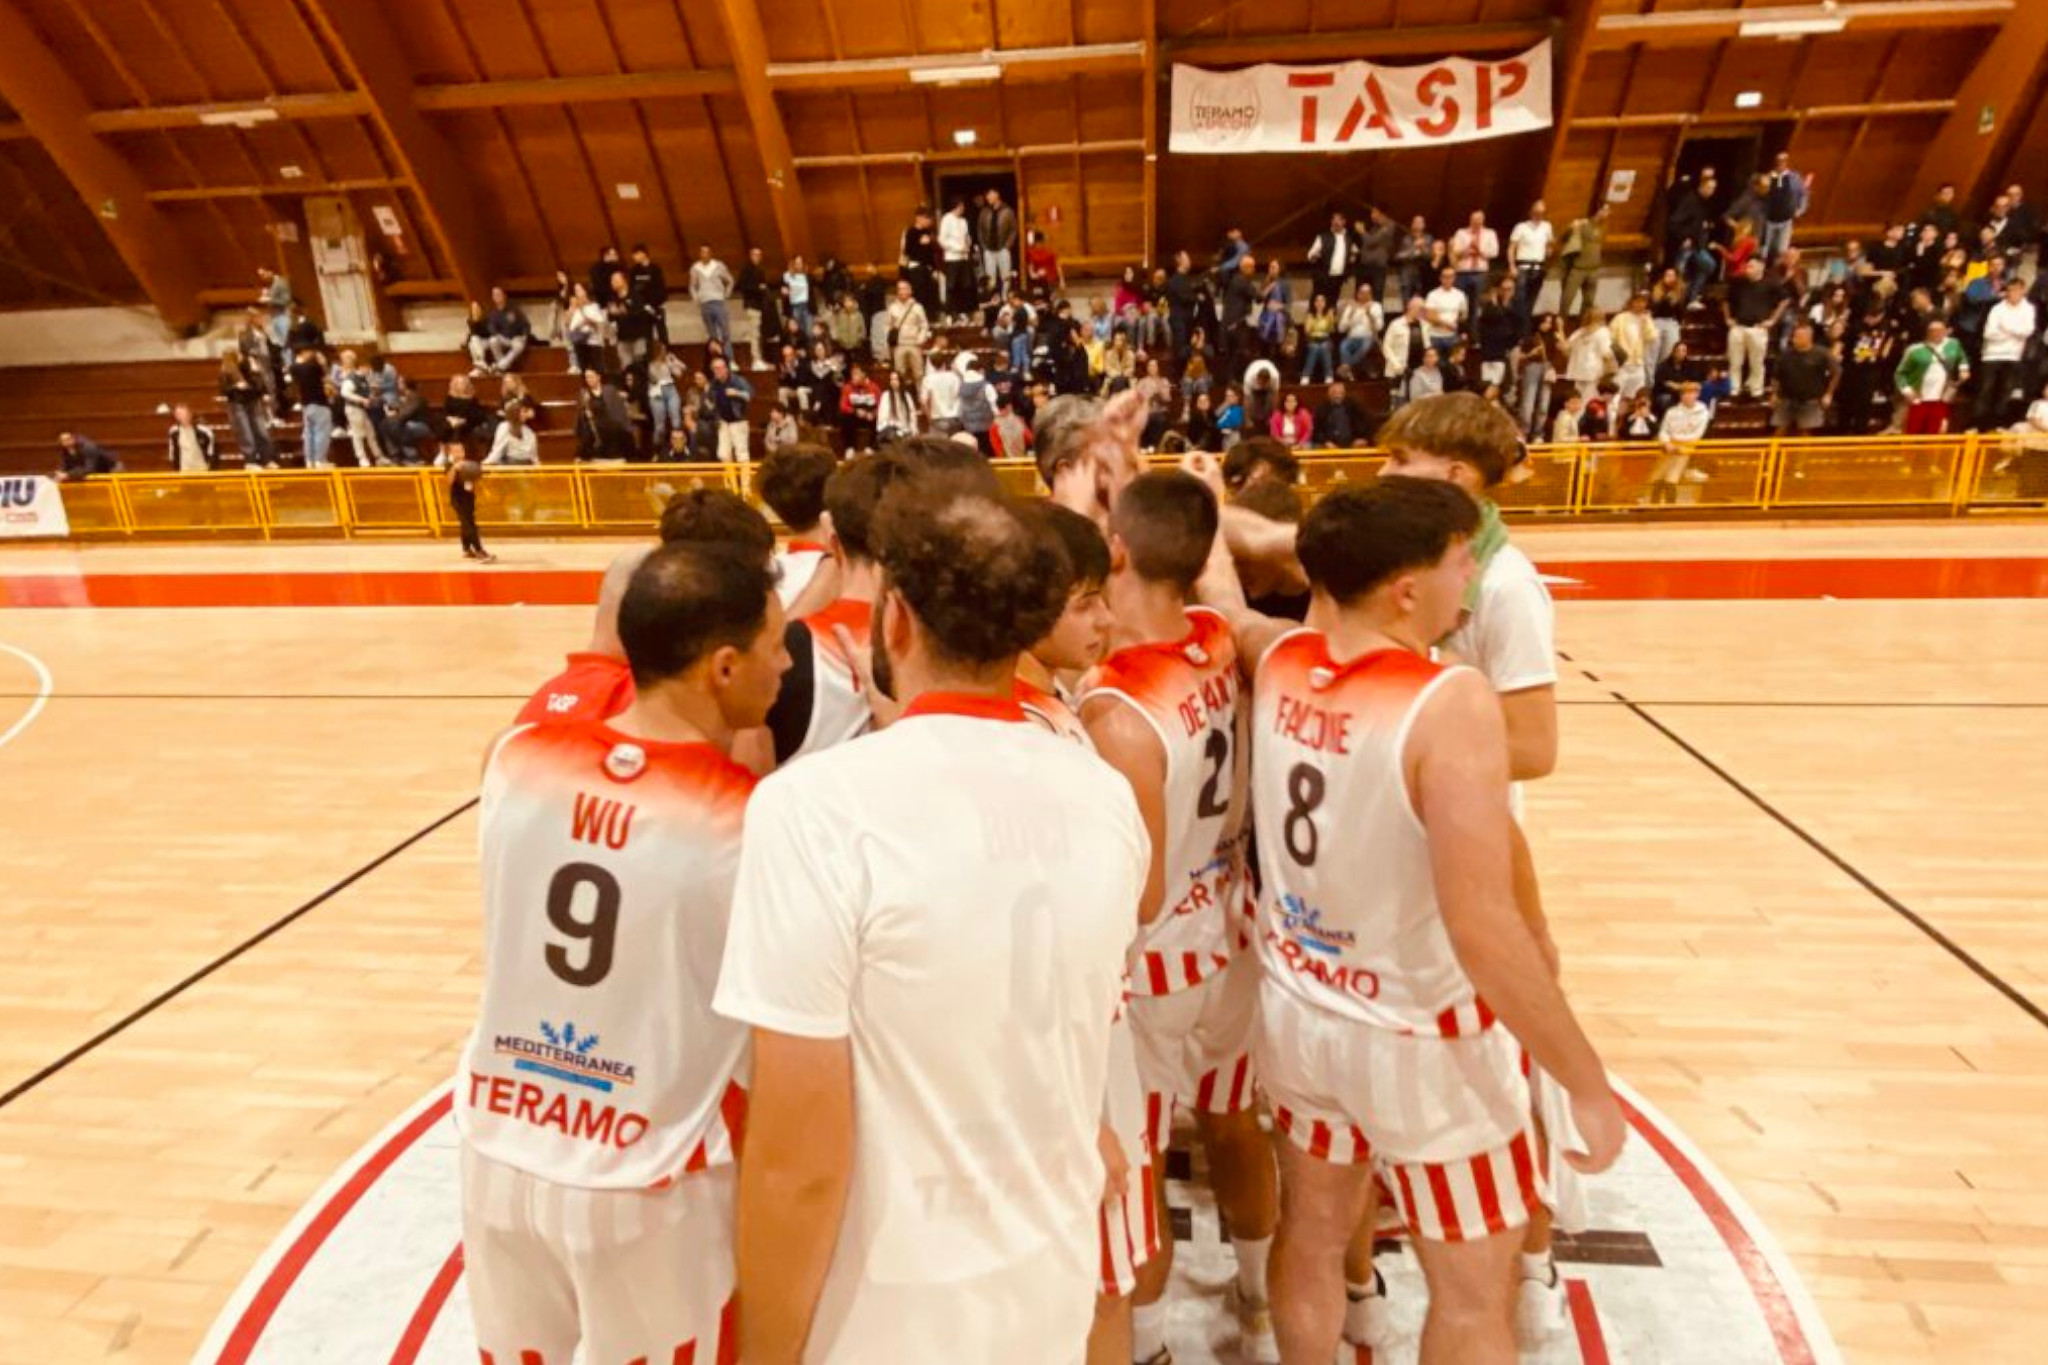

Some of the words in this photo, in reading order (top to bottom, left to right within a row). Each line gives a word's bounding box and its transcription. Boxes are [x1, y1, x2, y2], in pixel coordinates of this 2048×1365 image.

[1287, 61, 1529, 143] TASP
[571, 791, 636, 850] WU
[1284, 762, 1325, 868] 8
[545, 861, 621, 988] 9
[493, 1034, 637, 1080] MEDITERRANEA
[468, 1071, 651, 1151] TERAMO
